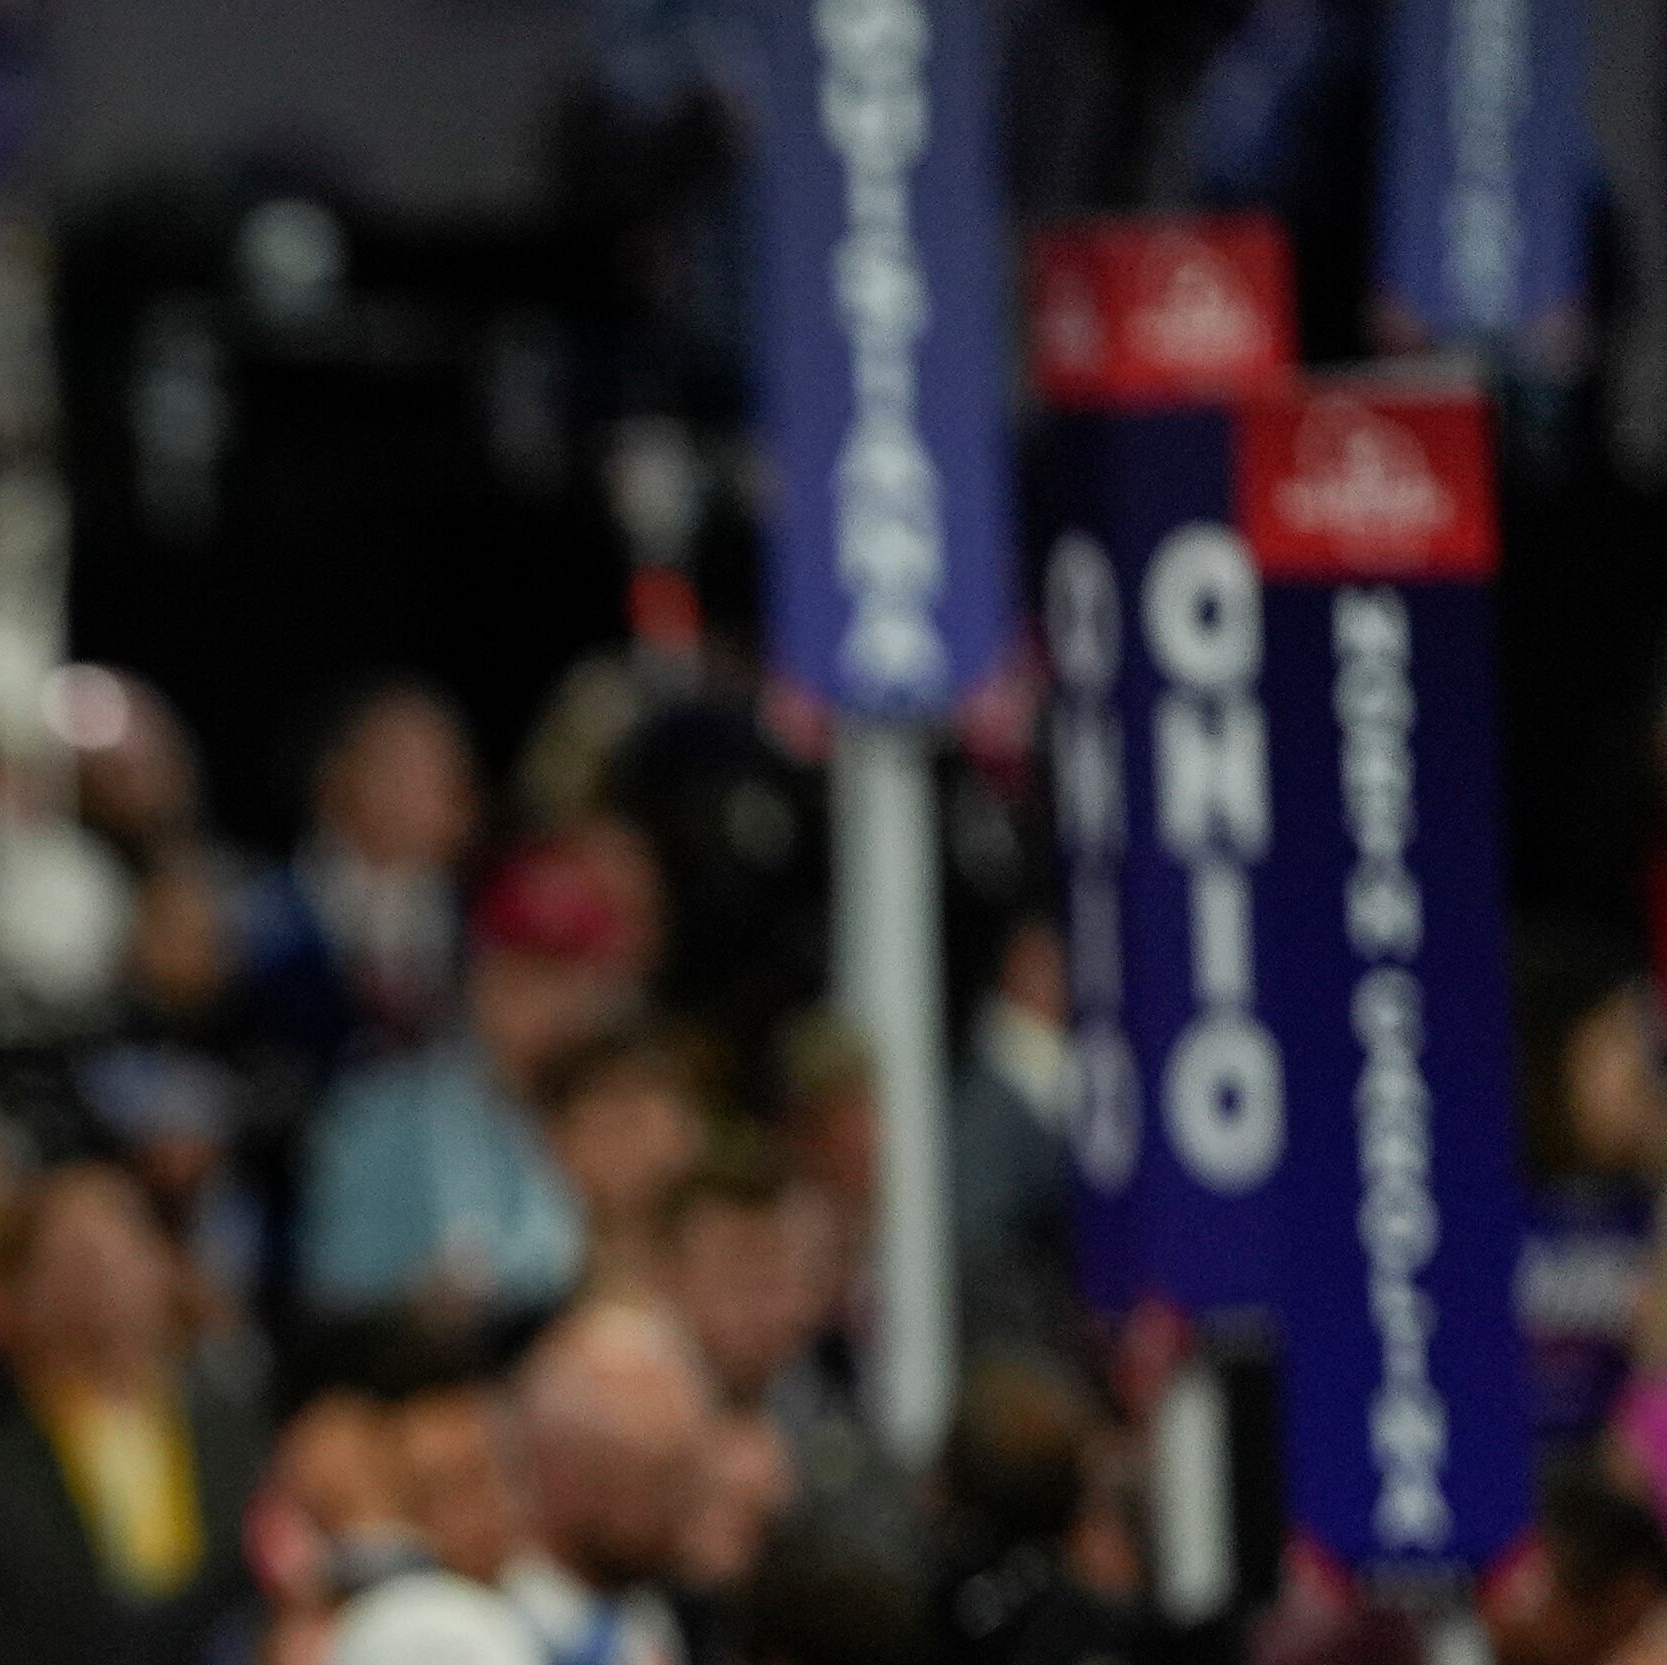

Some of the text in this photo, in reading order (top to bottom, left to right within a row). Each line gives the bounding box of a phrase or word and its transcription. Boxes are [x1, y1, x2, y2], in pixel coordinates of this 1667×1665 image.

[1140, 524, 1287, 1192] OHIO
[1332, 588, 1421, 957] NORTH
[1349, 966, 1449, 1550] CAROLINA
